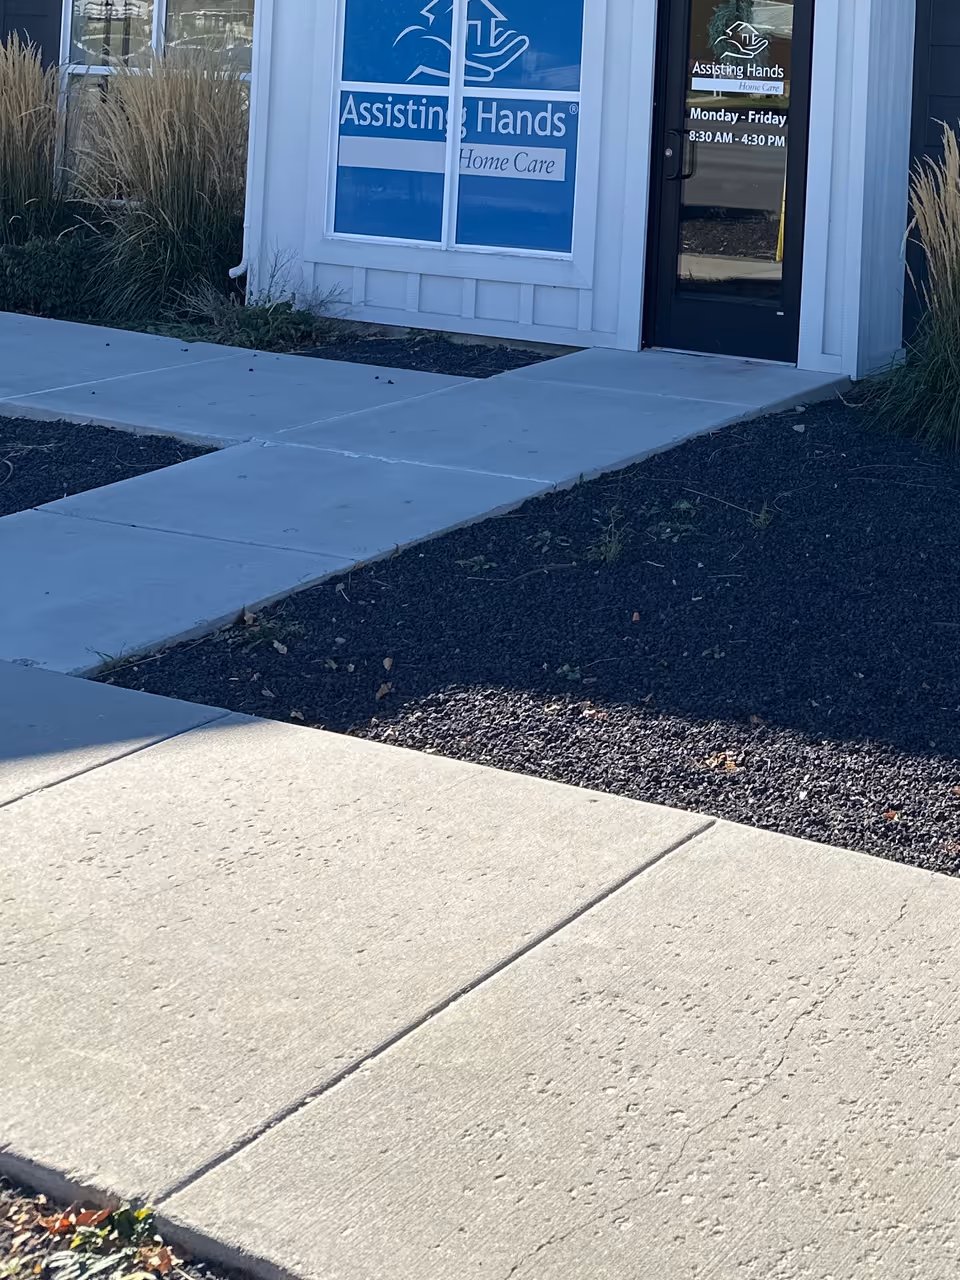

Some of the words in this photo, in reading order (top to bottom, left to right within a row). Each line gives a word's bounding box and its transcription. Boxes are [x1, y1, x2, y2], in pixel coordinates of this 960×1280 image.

[692, 61, 743, 79] Assisting
[747, 63, 784, 78] Hands
[739, 81, 760, 91] Home
[762, 83, 780, 93] Care
[690, 107, 739, 125] Monday
[748, 110, 787, 128] Friday
[689, 130, 712, 142] 8:30
[714, 131, 733, 143] AM
[741, 133, 765, 146] 4:30
[767, 135, 785, 147] PM
[459, 148, 509, 171] Home
[513, 151, 555, 174] Care
